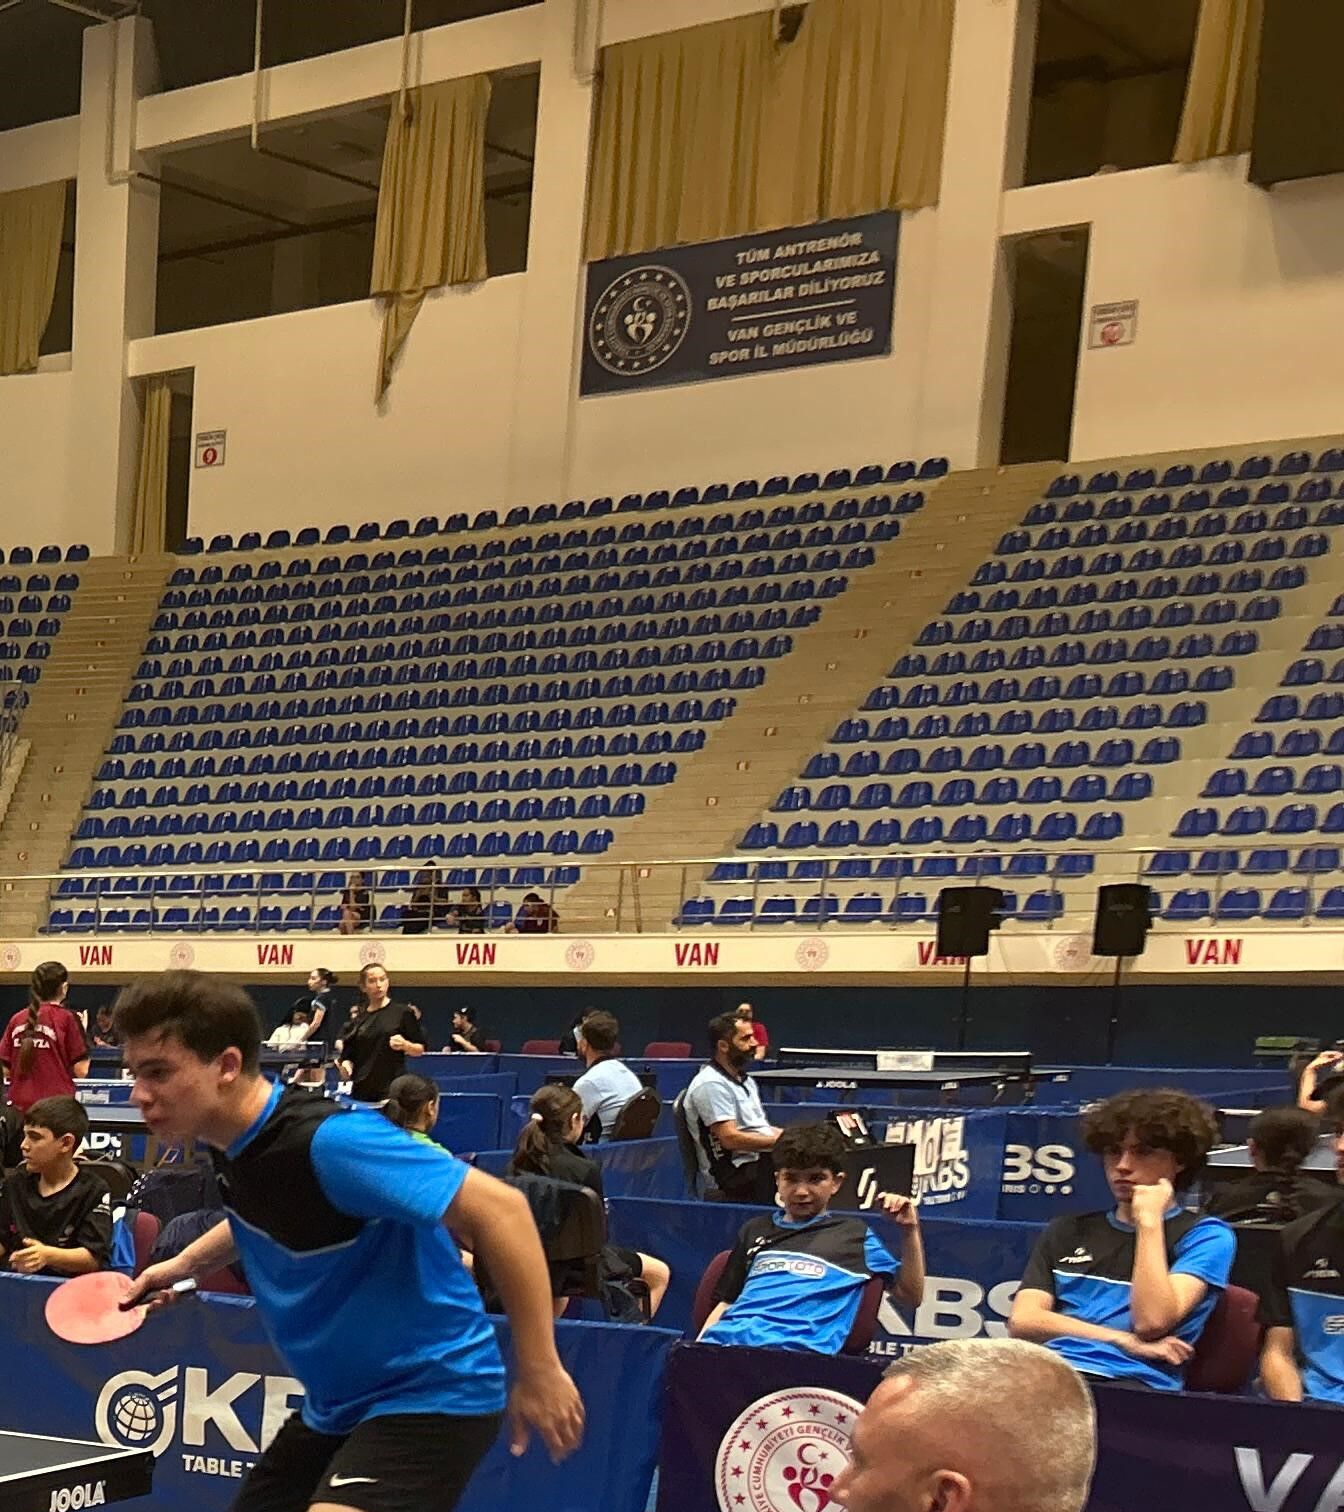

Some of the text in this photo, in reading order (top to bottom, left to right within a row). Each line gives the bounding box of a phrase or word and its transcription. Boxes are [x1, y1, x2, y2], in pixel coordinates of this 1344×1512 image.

[736, 231, 863, 266] TÜM ANTRENÖR
[715, 250, 881, 289] VE SPORCULARIMIZA
[707, 270, 887, 311] BAŞARILAR DİLİYORUZ
[727, 311, 858, 342] VAN GENÇLİK VE
[709, 347, 750, 365] SPOR
[80, 945, 113, 966] VAN
[257, 943, 294, 966] VAN
[456, 942, 497, 967] VAN
[675, 942, 720, 967] VAN
[1184, 938, 1243, 965] VAN
[1002, 1144, 1076, 1183] BS
[182, 1454, 243, 1478] TABLE
[752, 1427, 794, 1492] CUMHURİYETİ
[796, 1425, 846, 1445] GENÇLİK
